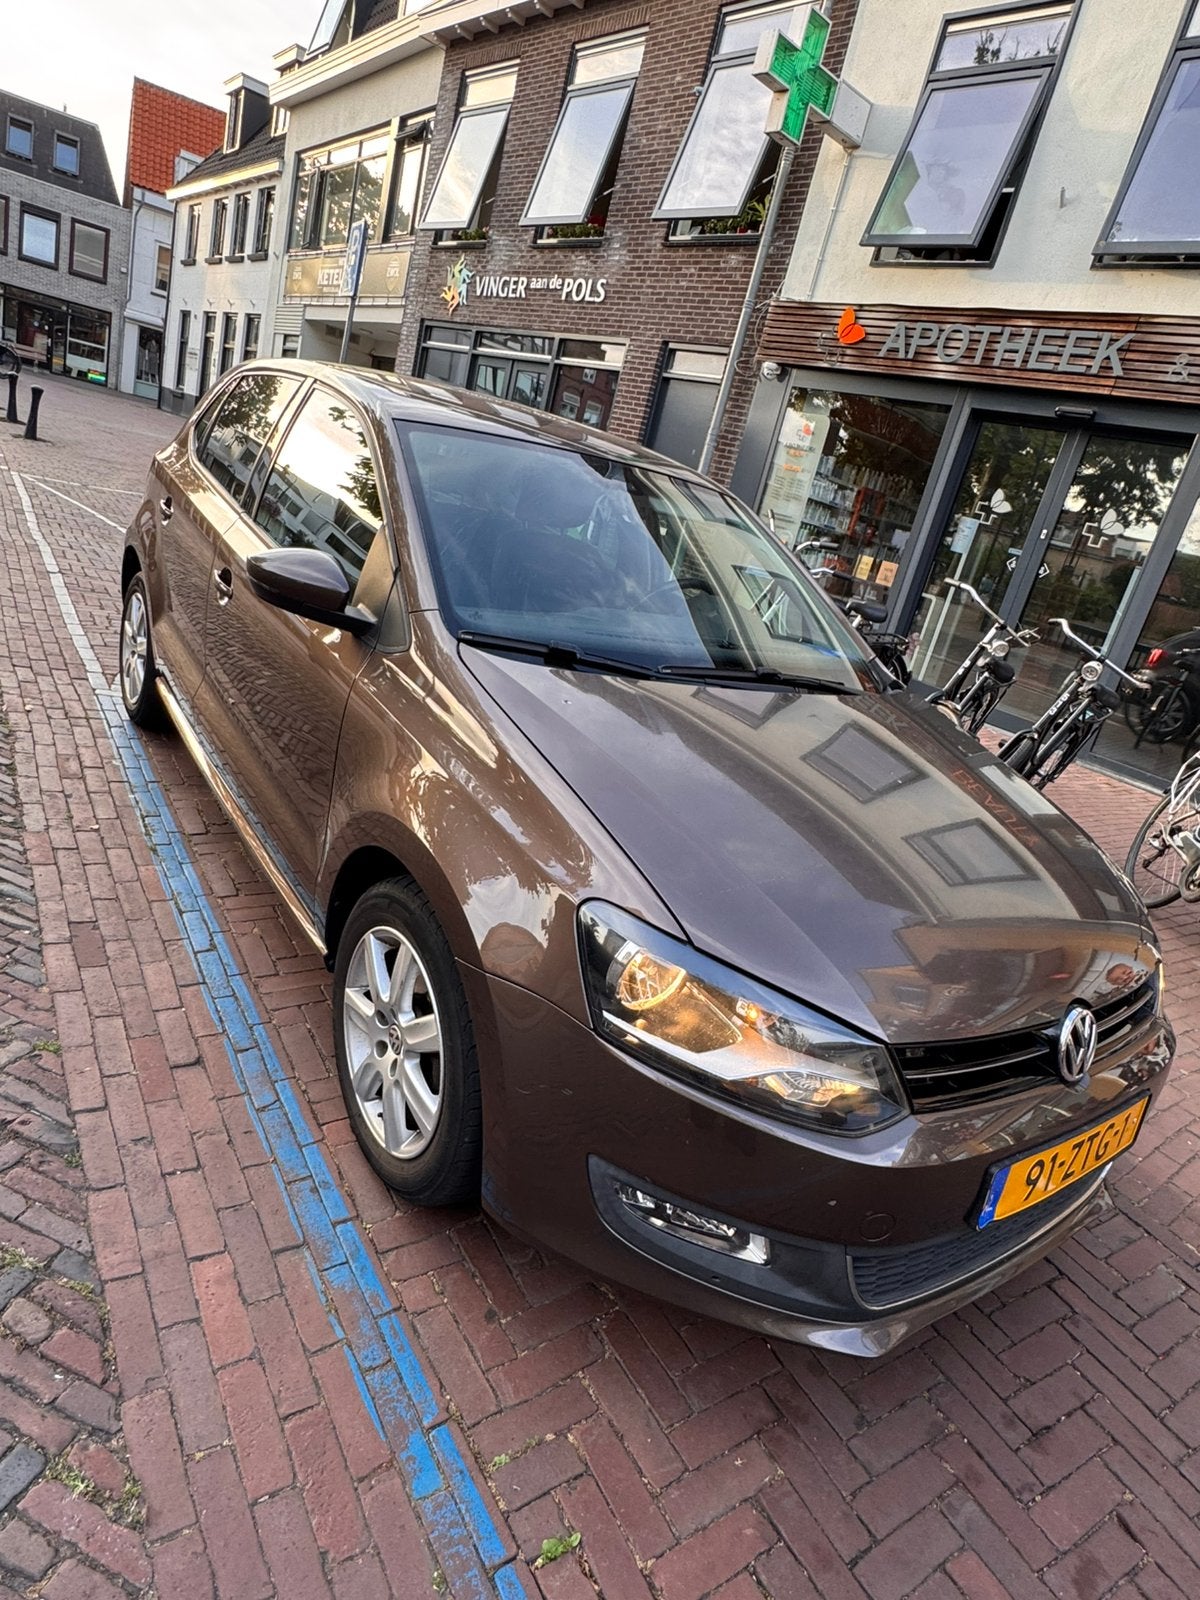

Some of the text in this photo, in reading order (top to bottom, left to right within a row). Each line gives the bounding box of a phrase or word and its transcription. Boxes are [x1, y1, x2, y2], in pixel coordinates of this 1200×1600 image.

[475, 274, 607, 303] VINGER aan de POLS
[877, 321, 1137, 377] APOTHEEK
[1023, 1112, 1132, 1202] 91-ZTG-1
